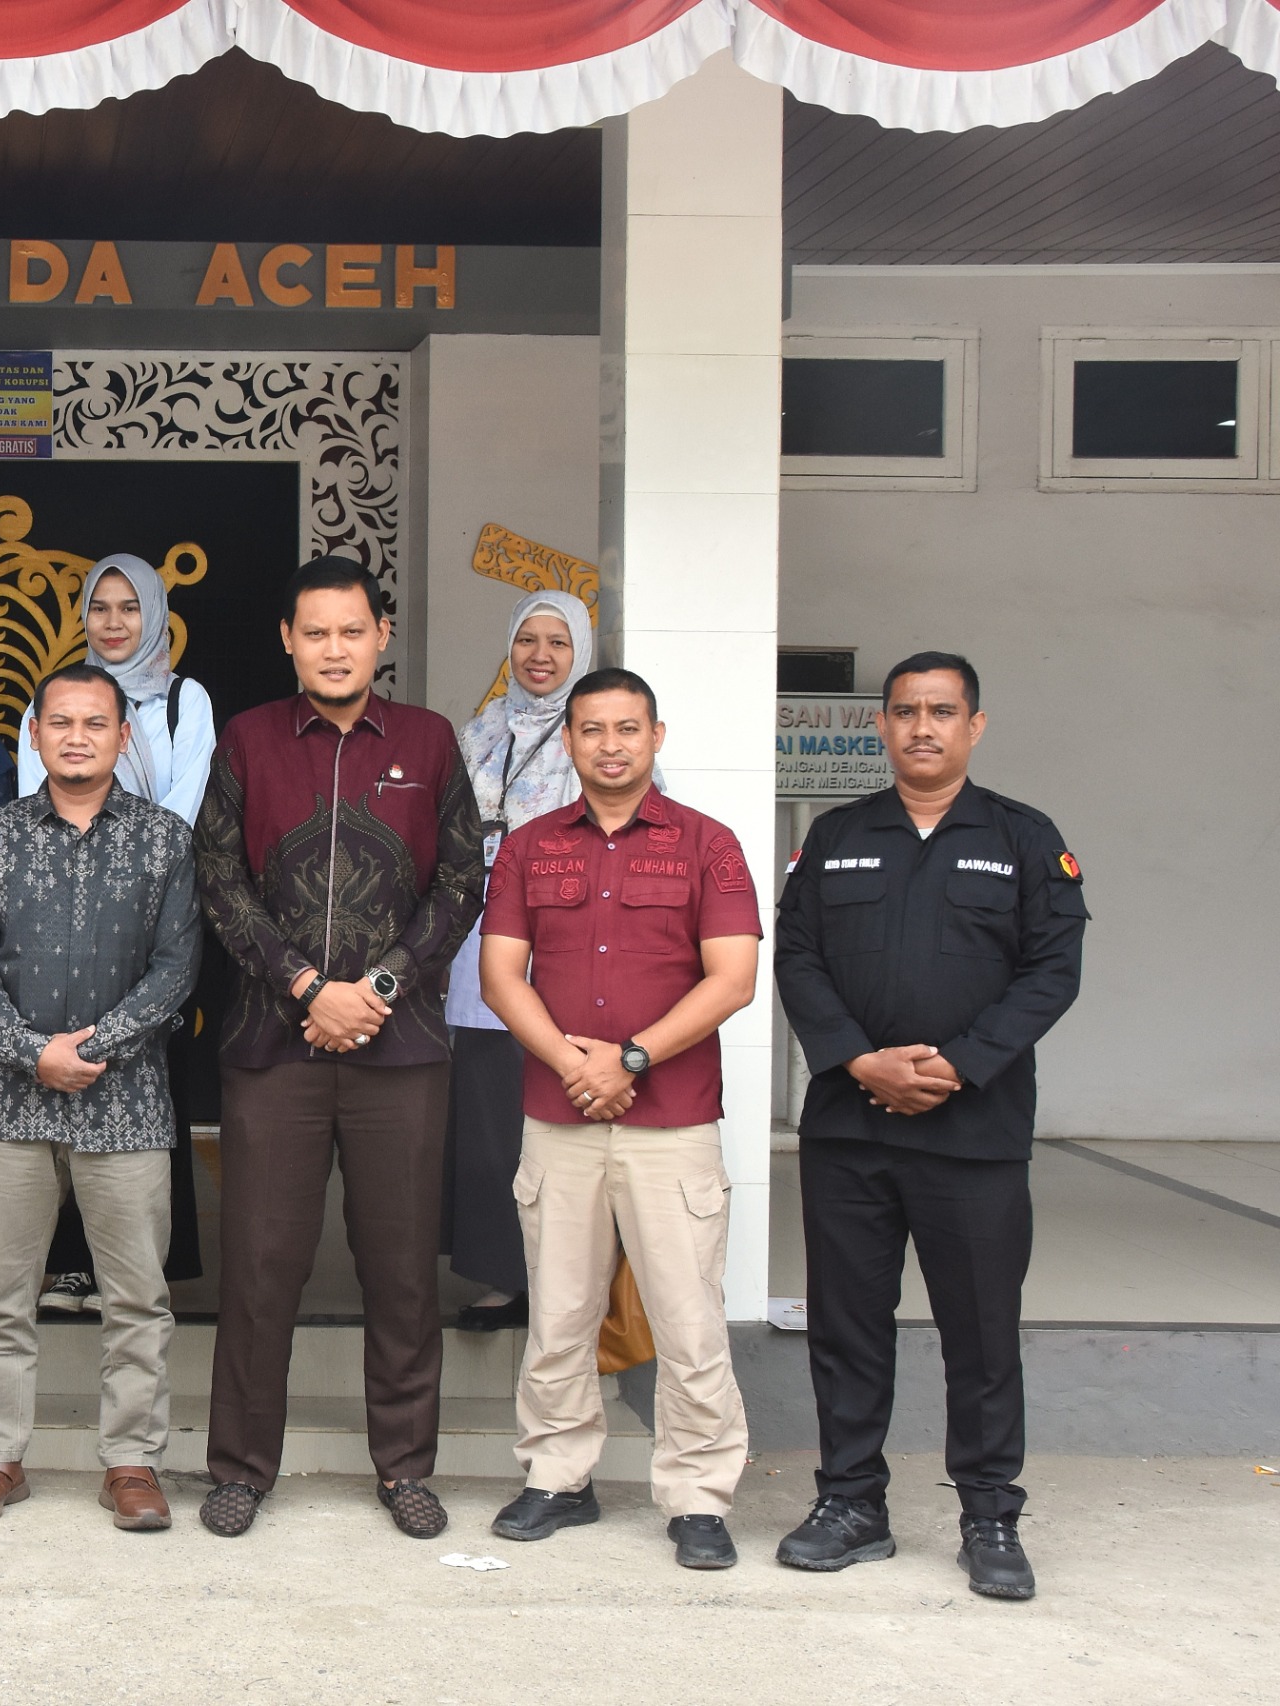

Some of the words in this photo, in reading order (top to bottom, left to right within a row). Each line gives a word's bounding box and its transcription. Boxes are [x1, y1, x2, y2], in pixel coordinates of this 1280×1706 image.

[195, 243, 456, 309] ACEH
[22, 366, 45, 375] DAN
[4, 378, 50, 387] KORUPSI
[7, 397, 36, 405] YANG
[19, 420, 48, 428] KAMI
[776, 704, 832, 728] SAN
[830, 761, 887, 774] DENGAN
[791, 777, 815, 789] AIR
[818, 777, 888, 790] MENGALIR
[531, 859, 585, 876] RUSLAN
[629, 858, 674, 876] KUMHAM
[675, 861, 688, 877] RI
[956, 858, 1014, 876] BAWASLU
